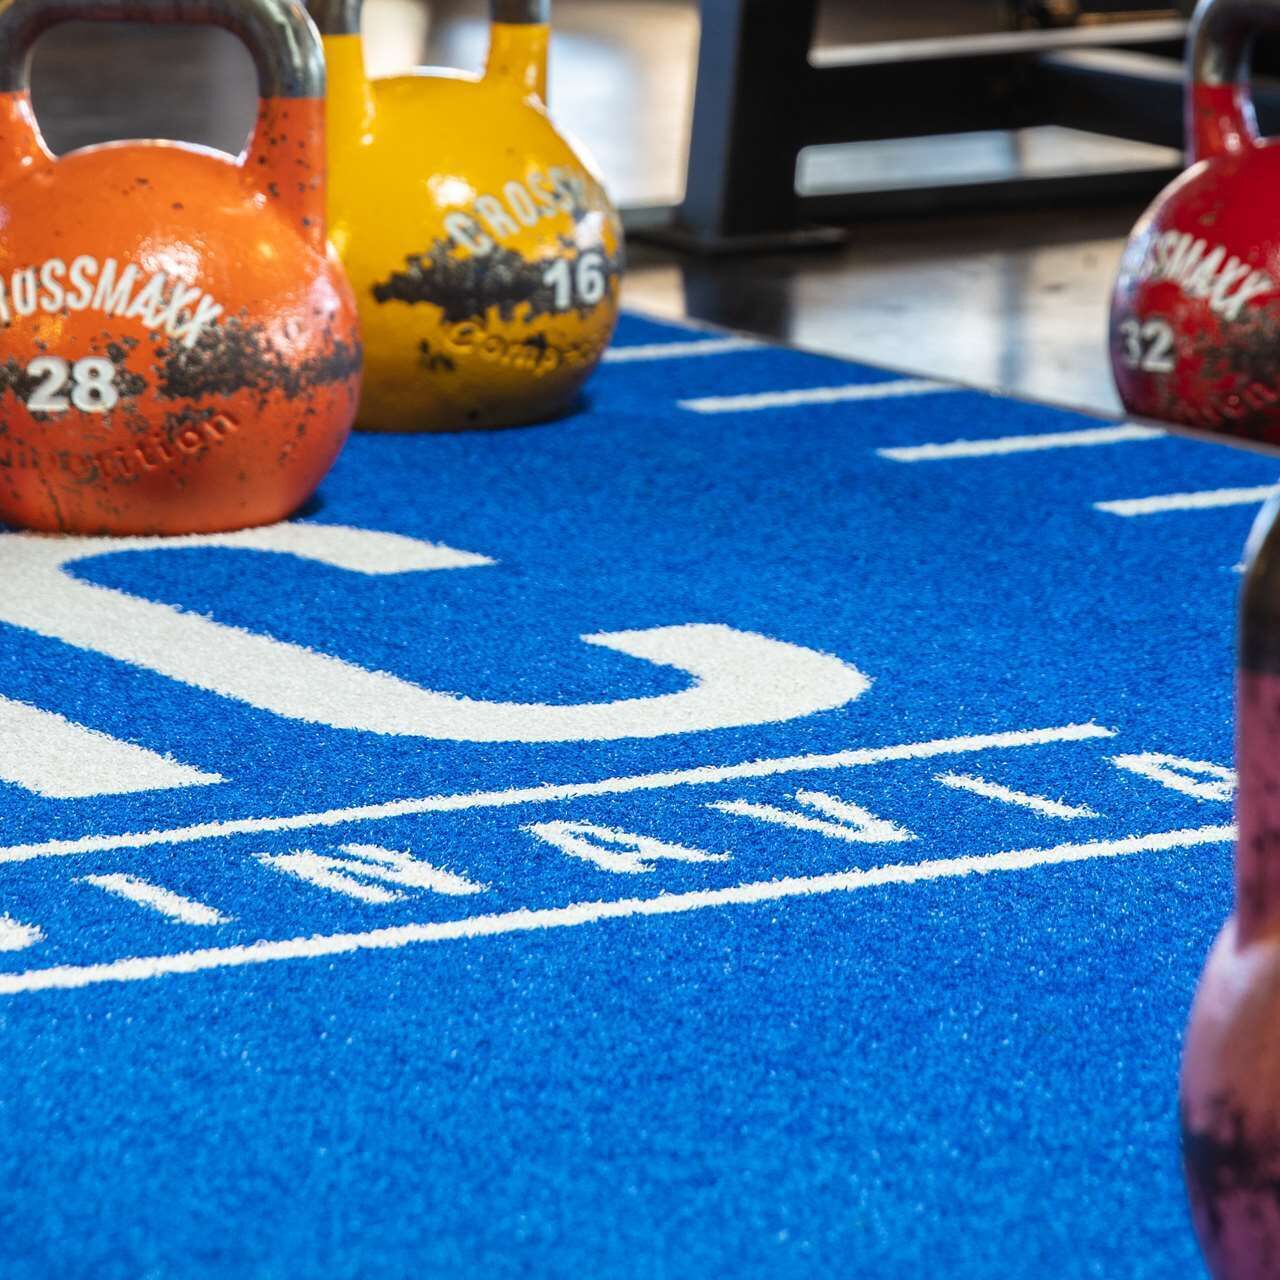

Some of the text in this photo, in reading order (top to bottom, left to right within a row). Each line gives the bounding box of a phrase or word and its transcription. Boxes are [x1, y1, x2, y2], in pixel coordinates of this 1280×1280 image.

[542, 251, 606, 310] 16
[1120, 319, 1176, 373] 32
[25, 354, 120, 414] 28
